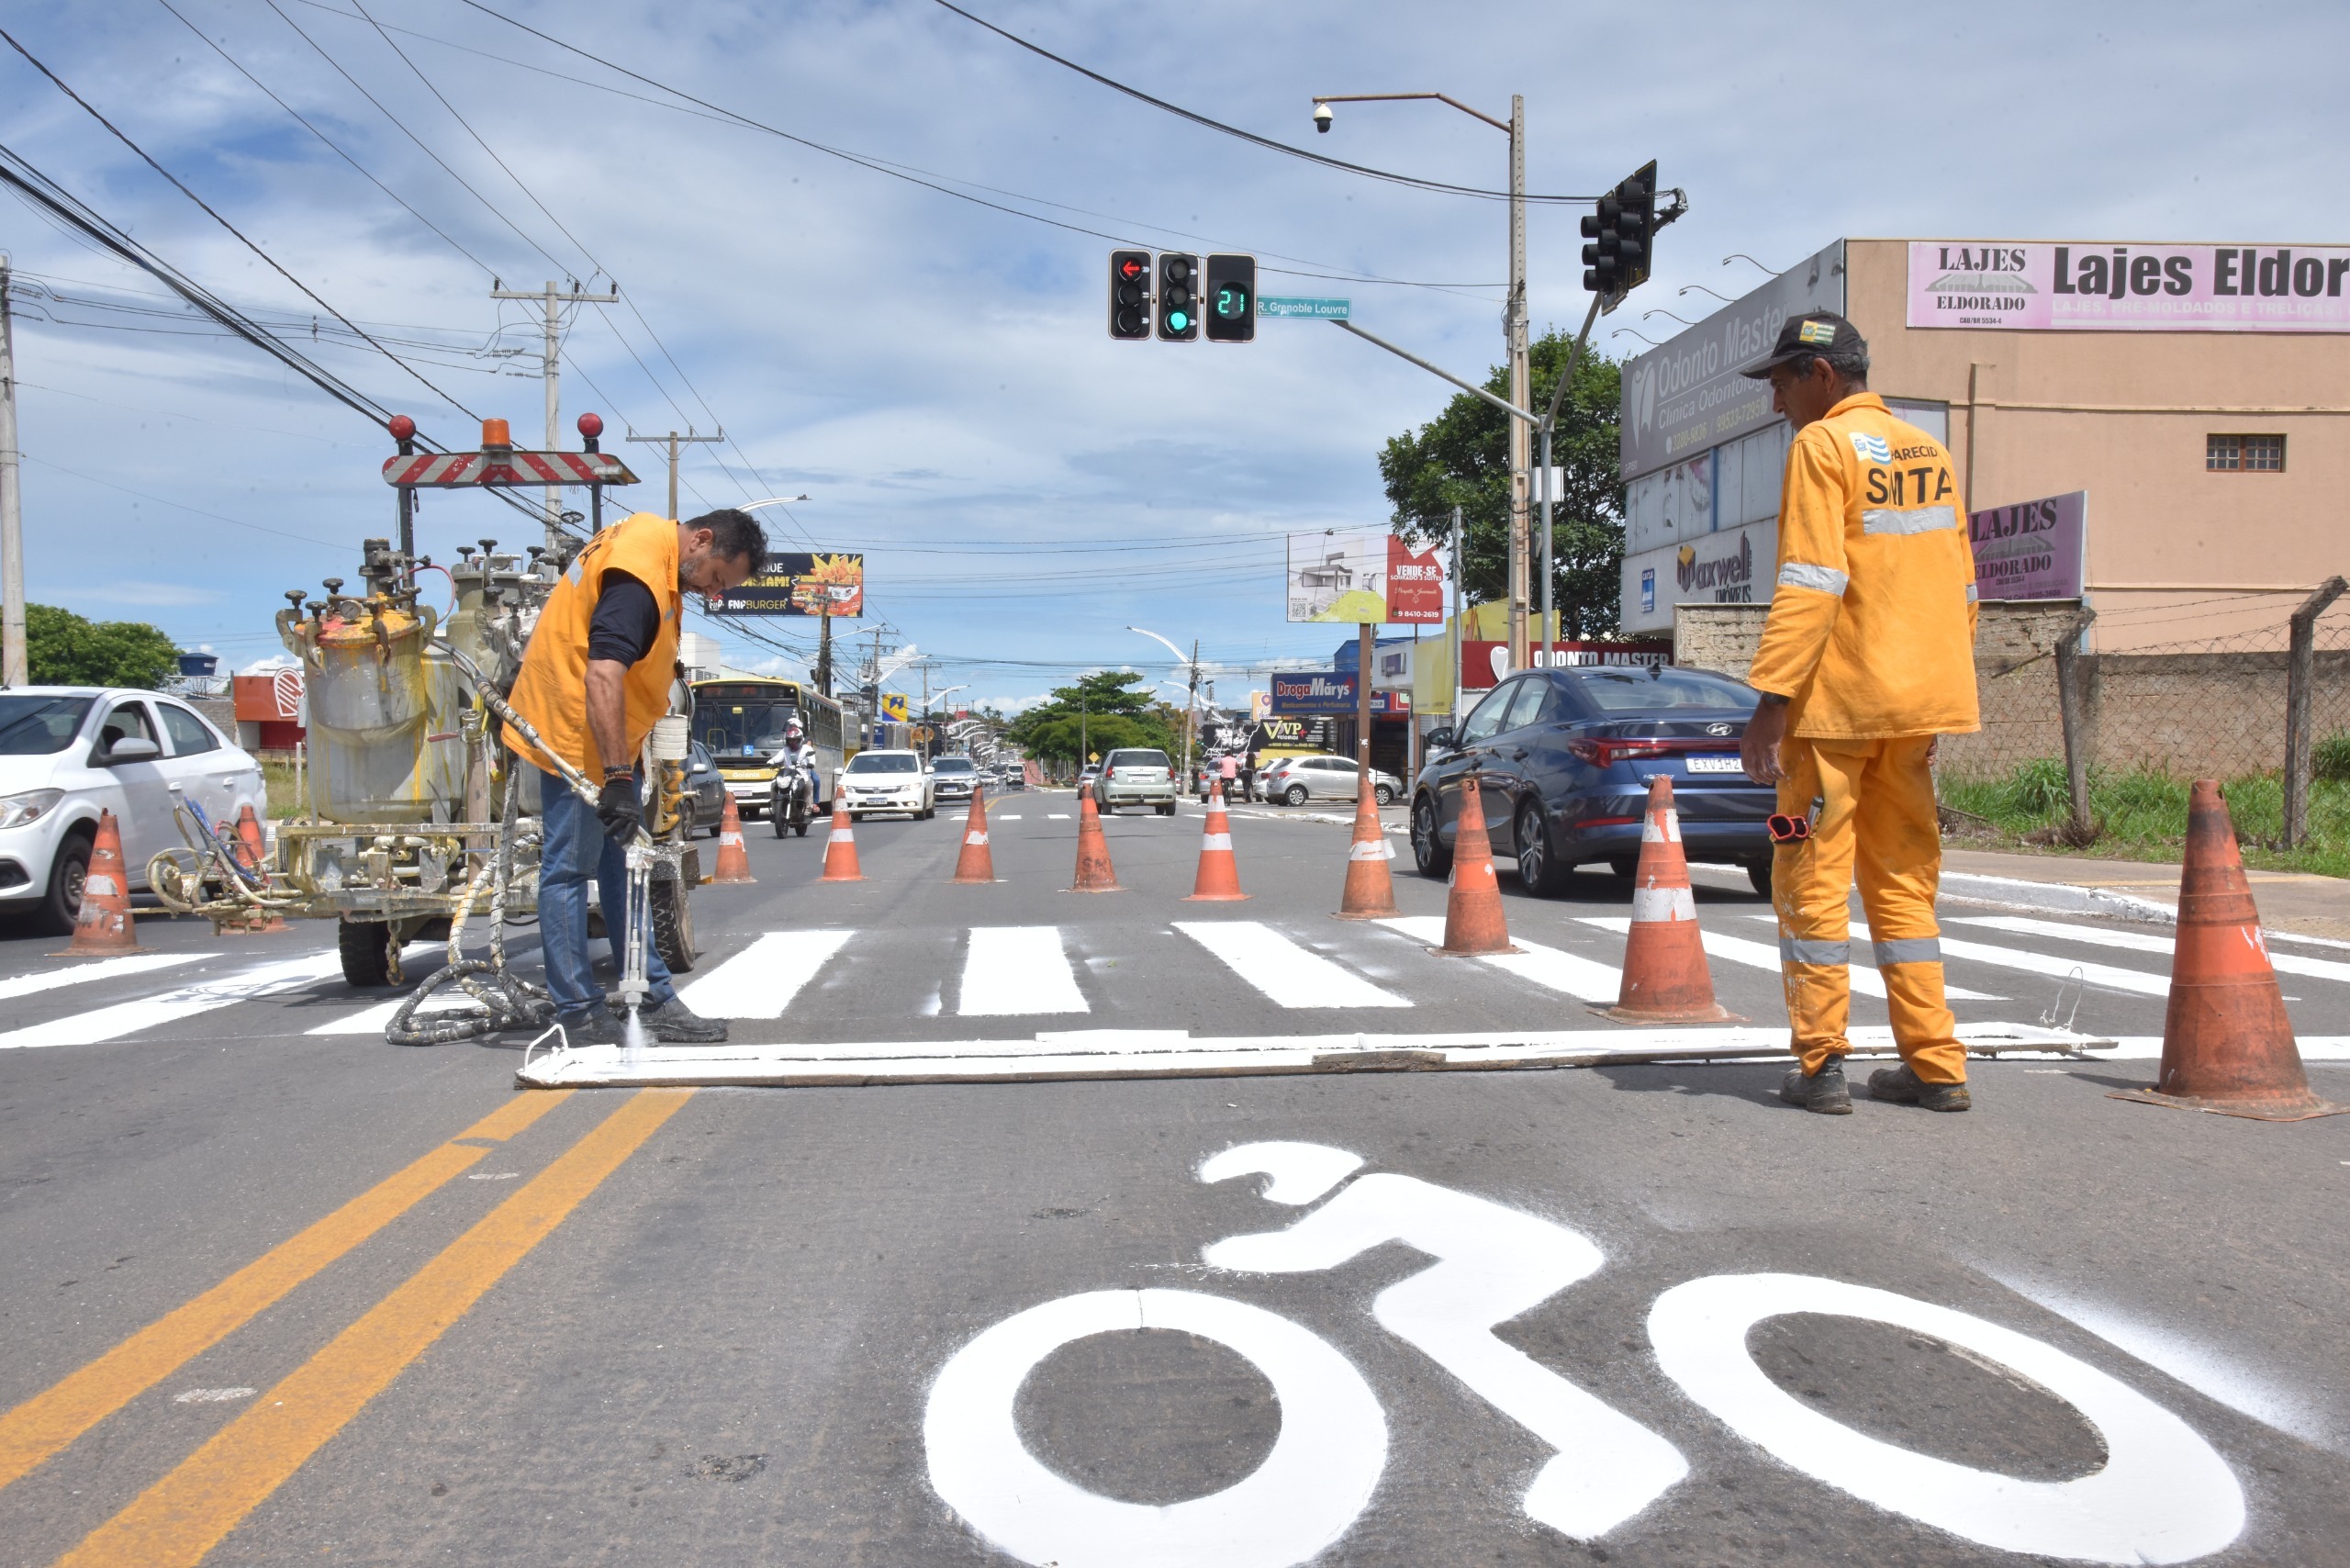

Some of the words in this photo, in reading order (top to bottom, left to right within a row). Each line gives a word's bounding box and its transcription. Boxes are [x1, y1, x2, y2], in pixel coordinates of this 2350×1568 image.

[1939, 247, 2026, 272] LAJES
[2053, 246, 2193, 300] Lajes
[1217, 290, 1245, 314] 21
[1257, 301, 1268, 312] R.
[1270, 302, 1313, 315] Grenoble
[1315, 305, 1348, 315] Louvre
[1936, 296, 2026, 310] ELDORADO
[1658, 336, 1718, 398] Odonto
[1723, 299, 1791, 367] Master
[1971, 498, 2057, 543] LAJES
[1396, 565, 1437, 577] VENDE-SE
[1676, 529, 1750, 593] Maxwell
[1975, 554, 2052, 580] ELDORADO
[1533, 650, 1599, 667] OONTO
[1604, 651, 1671, 668] MASTER
[1694, 758, 1740, 770] EXV1H2
